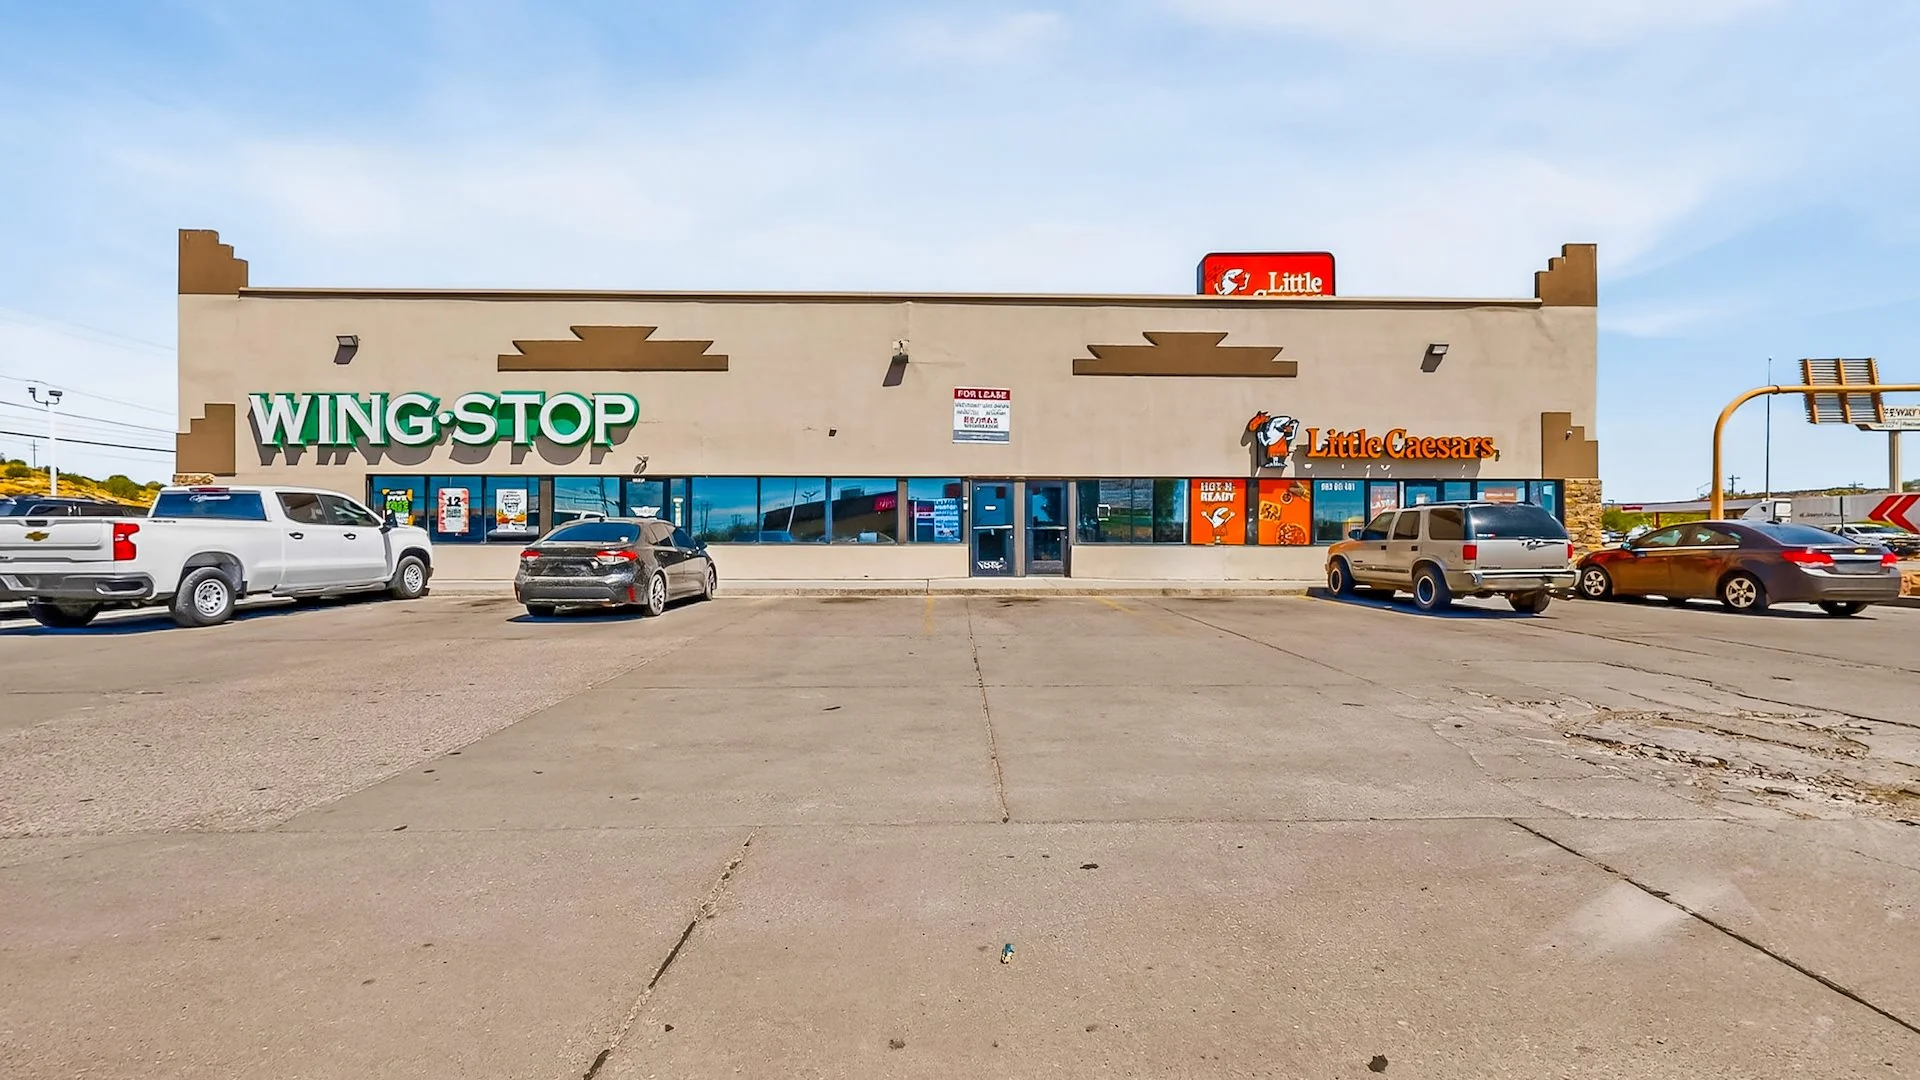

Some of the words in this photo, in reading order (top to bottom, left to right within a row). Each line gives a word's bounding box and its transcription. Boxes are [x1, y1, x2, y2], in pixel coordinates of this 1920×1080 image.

[1268, 271, 1323, 293] Little
[957, 390, 977, 398] FOR
[978, 390, 1007, 399] LEASE
[1305, 427, 1382, 459] Little
[1384, 427, 1495, 459] Caesars
[446, 496, 462, 507] 12
[1200, 492, 1236, 502] READY
